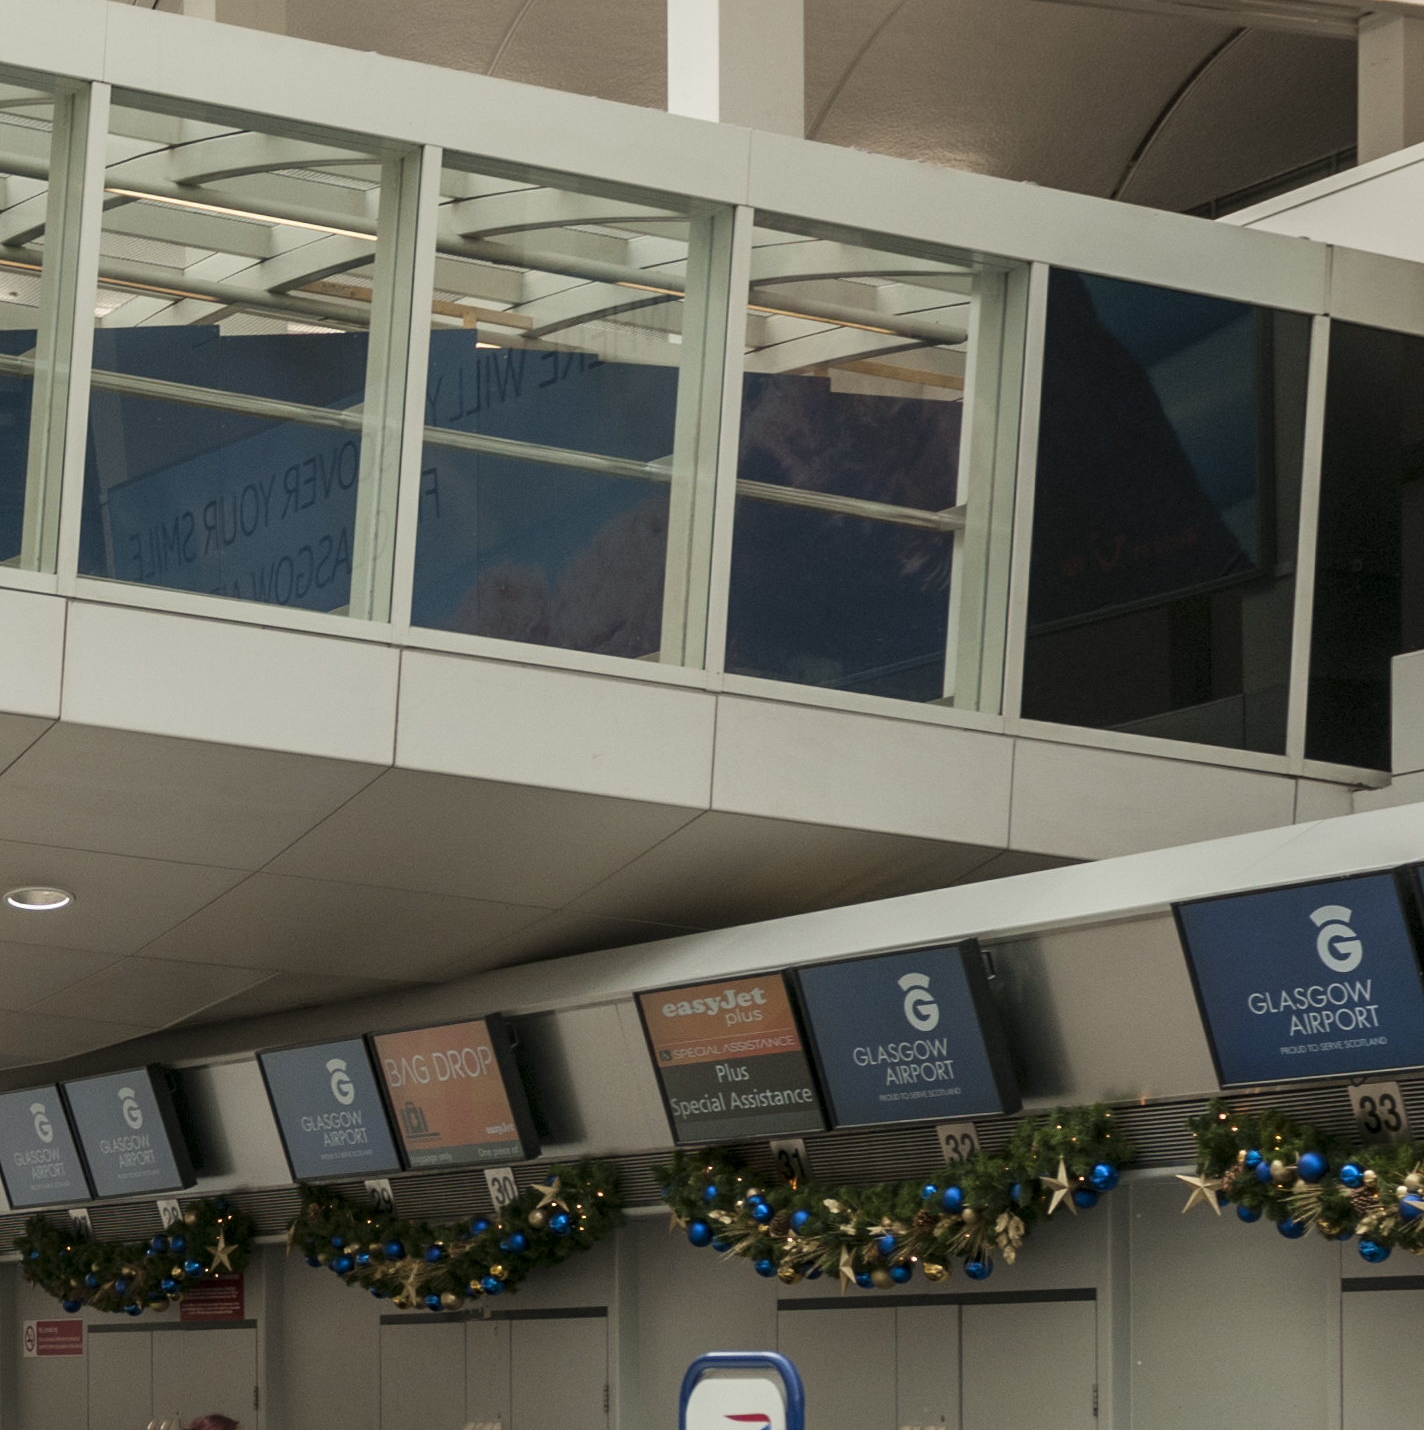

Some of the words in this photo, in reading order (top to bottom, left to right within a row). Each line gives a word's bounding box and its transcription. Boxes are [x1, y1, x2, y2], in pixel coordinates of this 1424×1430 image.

[662, 987, 767, 1018] easyJet
[1247, 979, 1372, 1014] GLASGOW
[725, 1007, 763, 1027] plus
[1290, 1005, 1379, 1036] AIRPORT
[672, 1044, 720, 1060] SPECIAL
[721, 1035, 795, 1055] ASSISTANCE
[853, 1038, 948, 1066] GLASGOW
[1308, 1044, 1319, 1053] TO
[1320, 1041, 1344, 1051] SERVE
[1345, 1036, 1388, 1049] SCOTLAND
[384, 1054, 430, 1088] BAG
[432, 1046, 492, 1082] DROP
[715, 1064, 750, 1083] Plus
[886, 1060, 954, 1086] AIRPORT
[671, 1093, 725, 1119] Special
[730, 1087, 813, 1110] Assistance
[1359, 1093, 1402, 1134] 33
[301, 1110, 363, 1132] GLASGOW
[99, 1134, 150, 1154] GLASGOW
[323, 1127, 368, 1148] AIRPORT
[13, 1147, 60, 1166] GLASGOW
[119, 1149, 156, 1168] AIRPORT
[778, 1148, 806, 1180] 31
[32, 1162, 65, 1180] AIRPORT
[491, 1176, 518, 1205] 30
